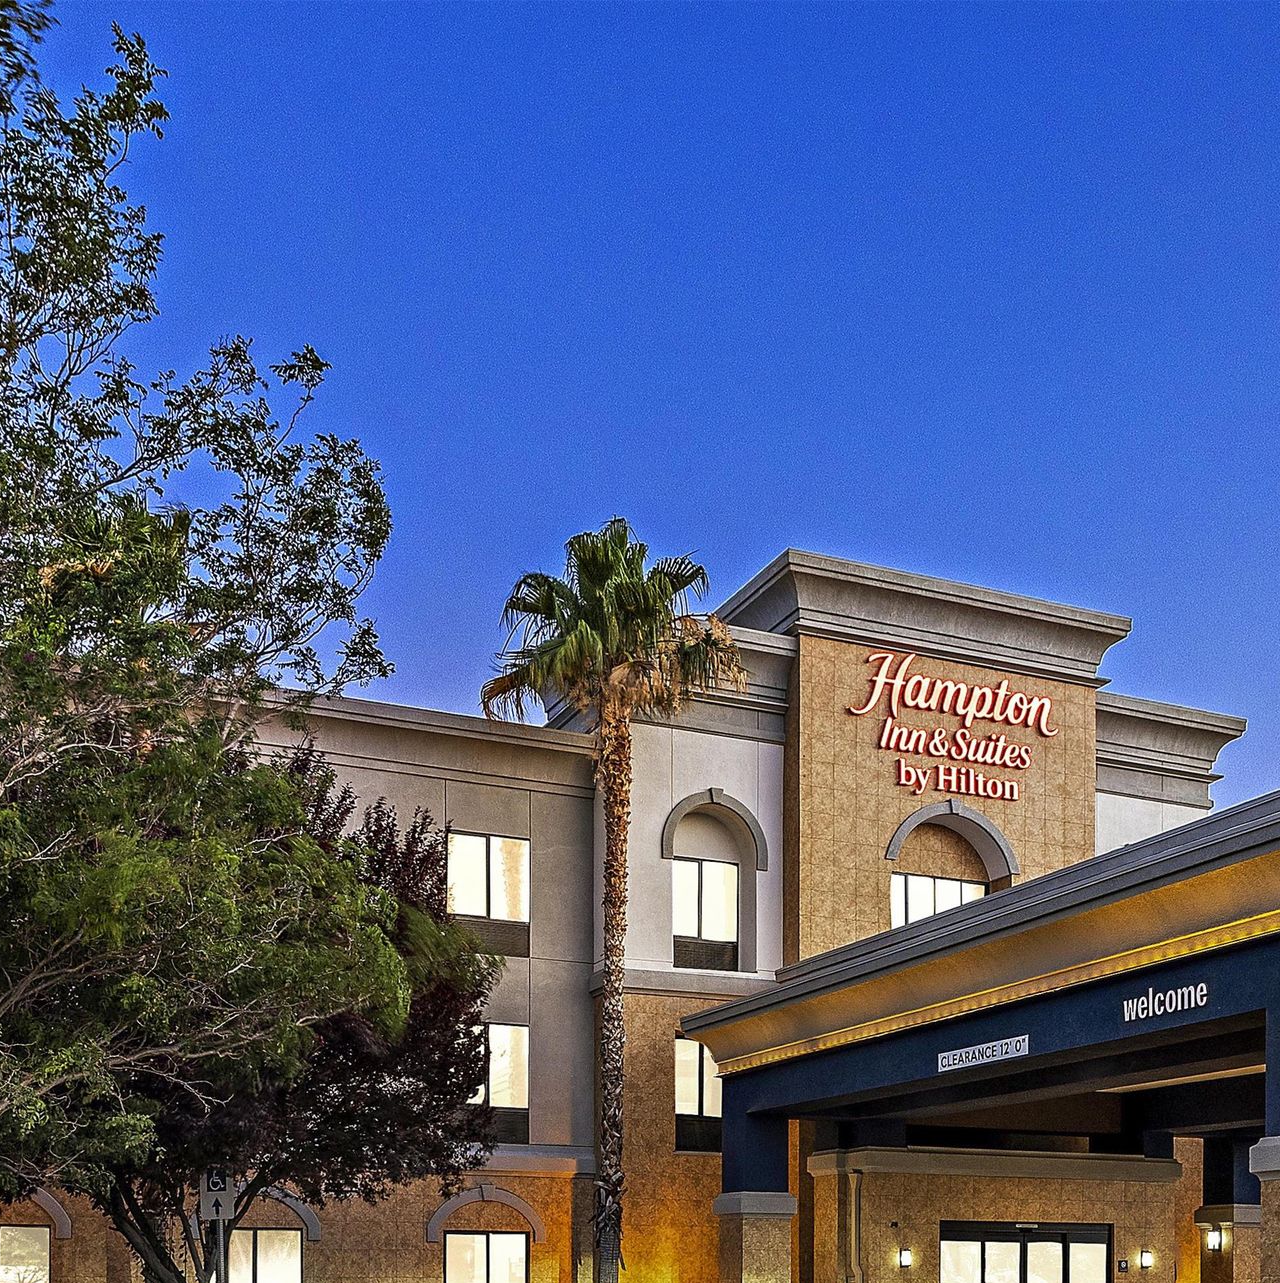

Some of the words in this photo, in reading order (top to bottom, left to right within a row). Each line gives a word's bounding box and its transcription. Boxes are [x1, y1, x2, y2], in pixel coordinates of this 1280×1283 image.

[846, 652, 1059, 737] Hampton
[879, 716, 928, 754] Inn
[928, 727, 950, 757] &
[950, 727, 1032, 769] Suites
[898, 758, 931, 795] by
[936, 764, 1020, 800] Hilton
[1123, 983, 1208, 1022] welcome
[941, 1045, 997, 1068] CLEARANCE
